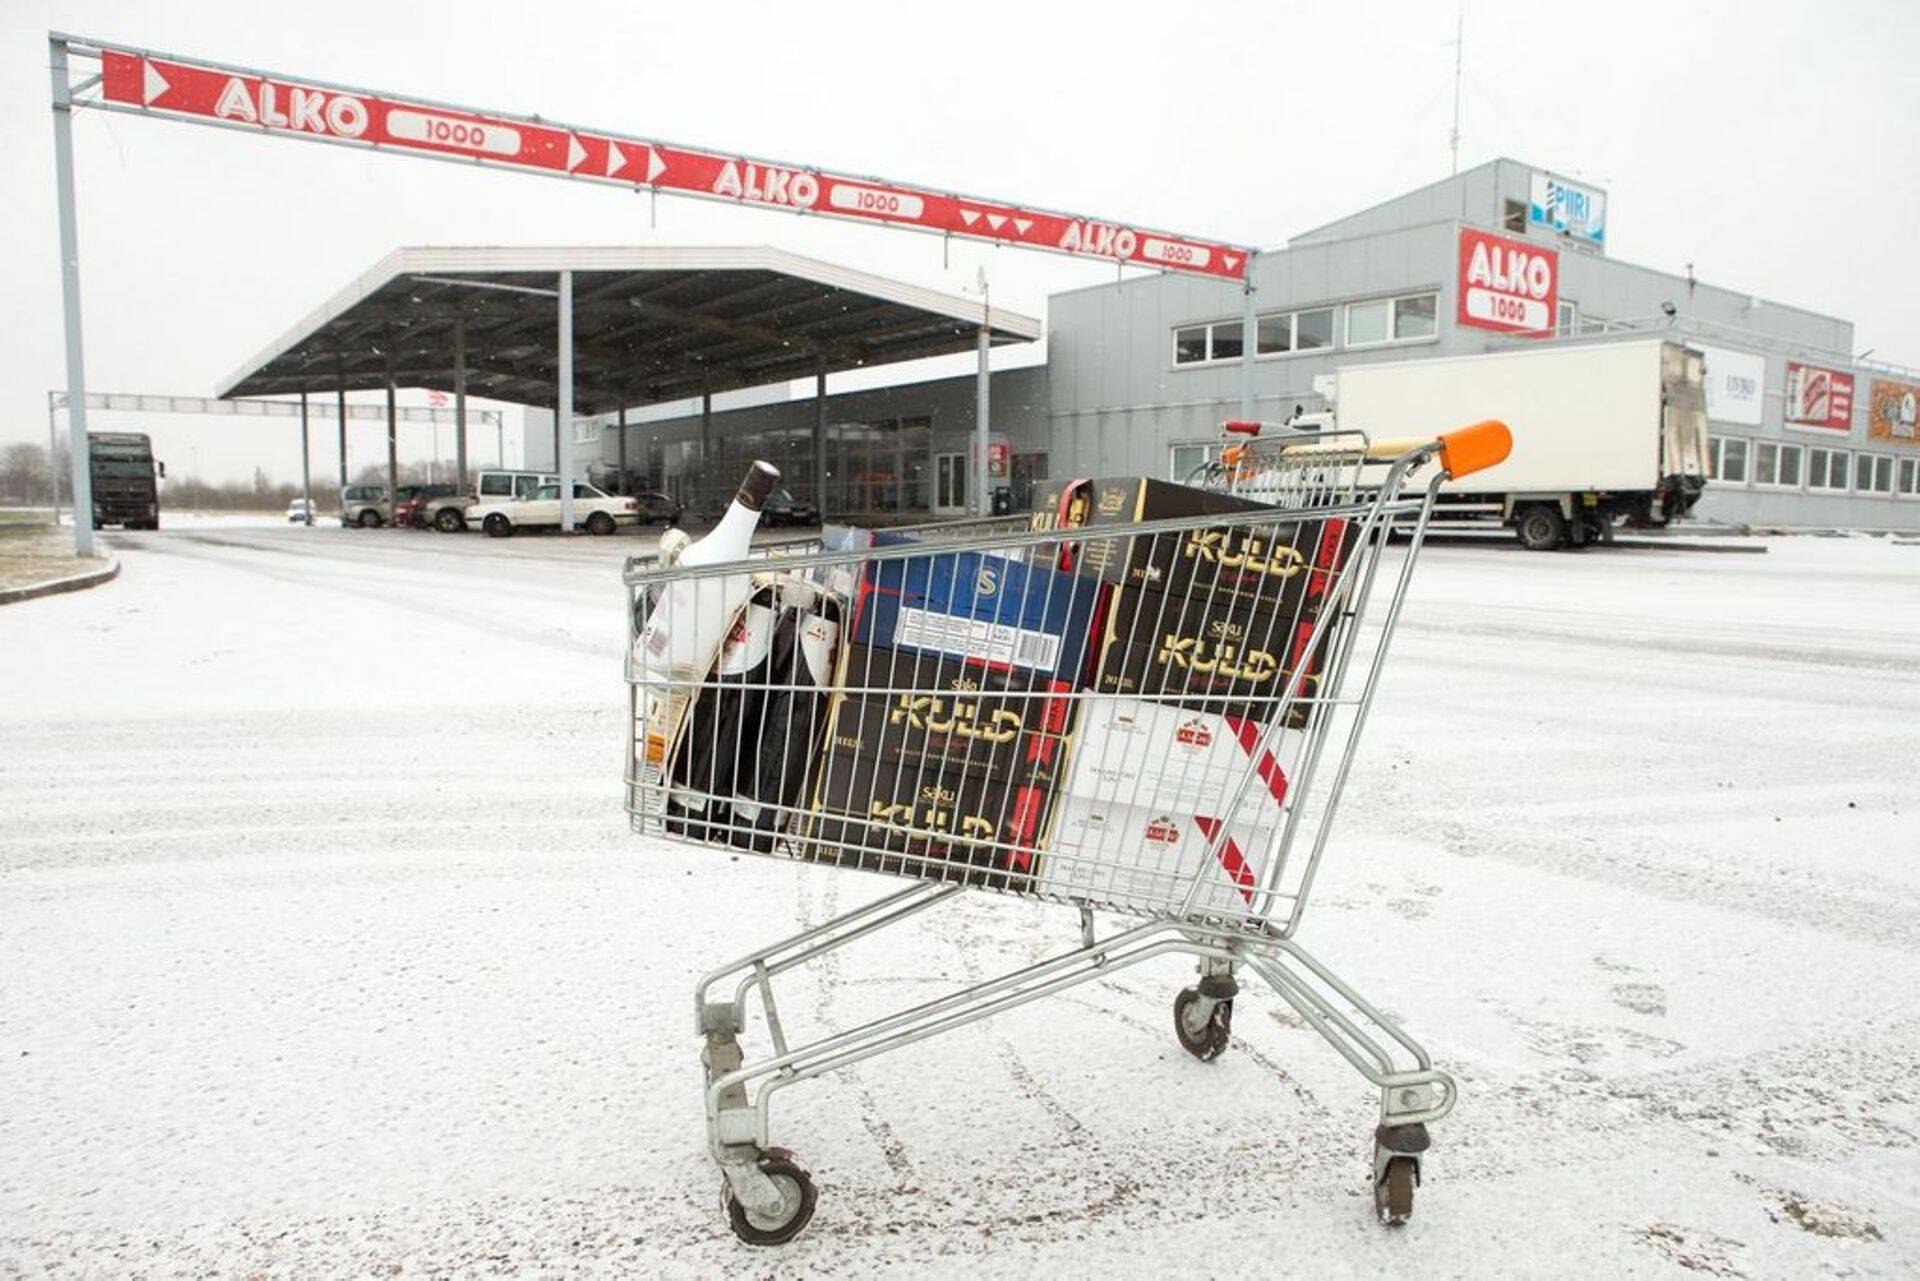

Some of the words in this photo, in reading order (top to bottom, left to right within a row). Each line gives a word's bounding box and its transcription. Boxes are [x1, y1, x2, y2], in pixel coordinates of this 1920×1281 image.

[214, 77, 369, 138] ALKO
[425, 118, 486, 147] 1000
[712, 161, 820, 208] ALKO
[856, 190, 900, 212] 1000
[1555, 185, 1591, 222] PIIRI
[1059, 218, 1137, 259] ALKO
[1161, 244, 1193, 262] 1000
[1467, 240, 1551, 299] ALKO
[1490, 296, 1527, 322] 1000
[1185, 527, 1304, 579] KULD
[1157, 633, 1277, 684] KULD
[891, 694, 1022, 744] KULD
